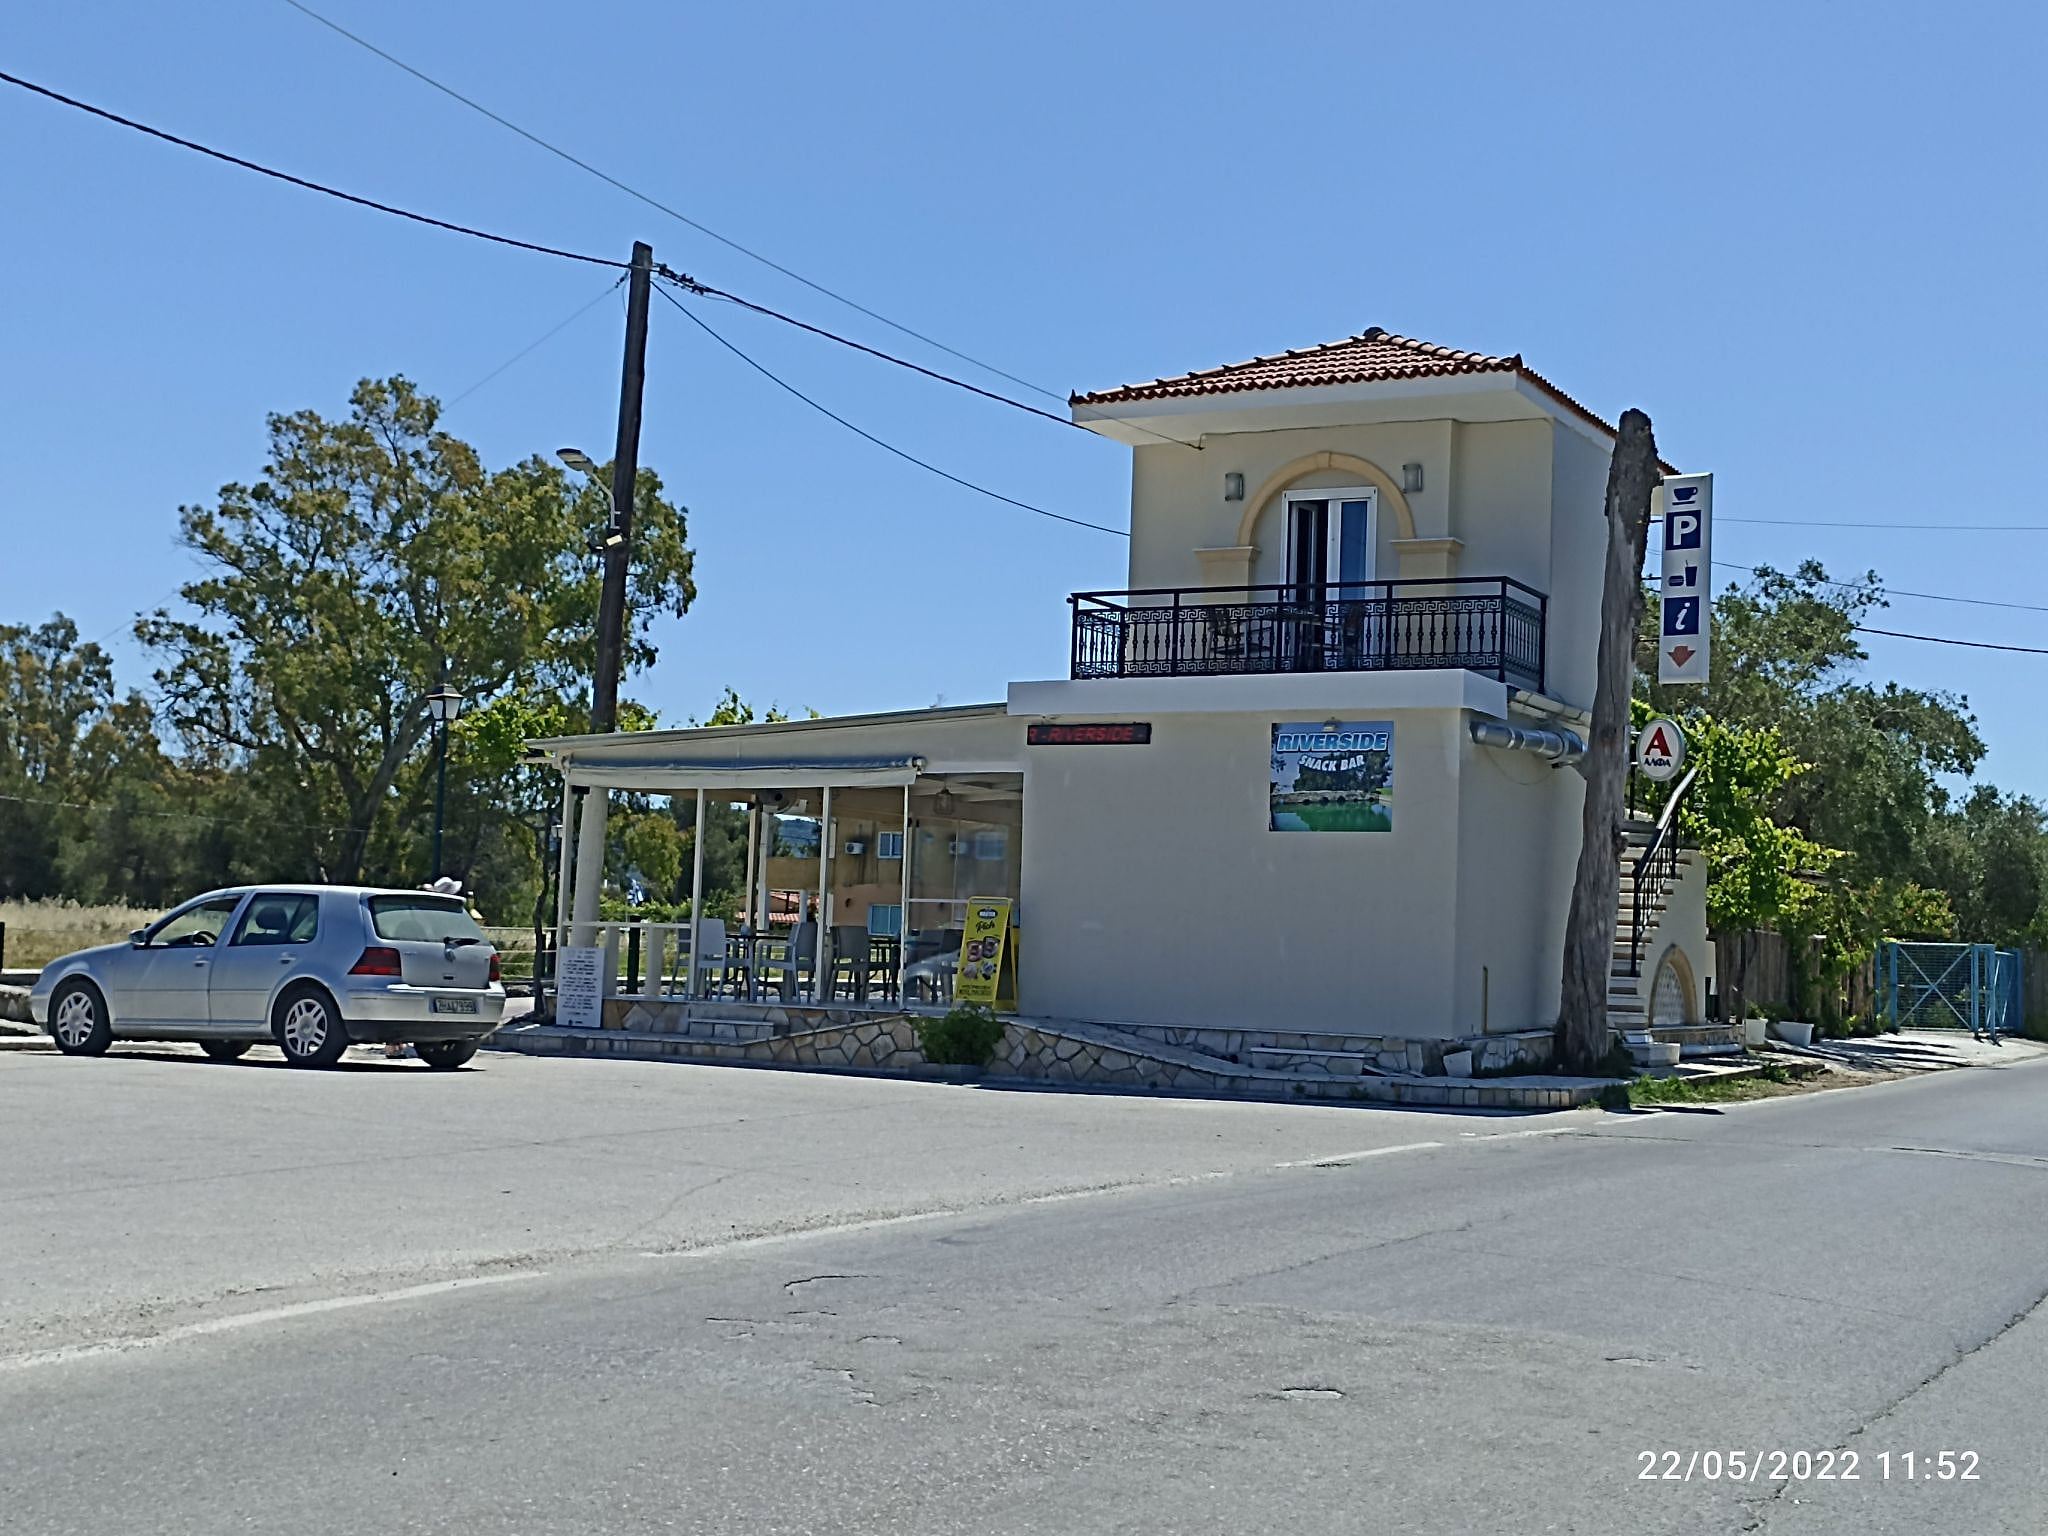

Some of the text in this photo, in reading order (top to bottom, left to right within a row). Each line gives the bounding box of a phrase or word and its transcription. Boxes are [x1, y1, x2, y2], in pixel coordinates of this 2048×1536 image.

[1672, 515, 1698, 546] P
[1675, 602, 1691, 631] i
[1276, 731, 1390, 752] RIVERSIDE
[1298, 754, 1365, 772] SNACK BAR
